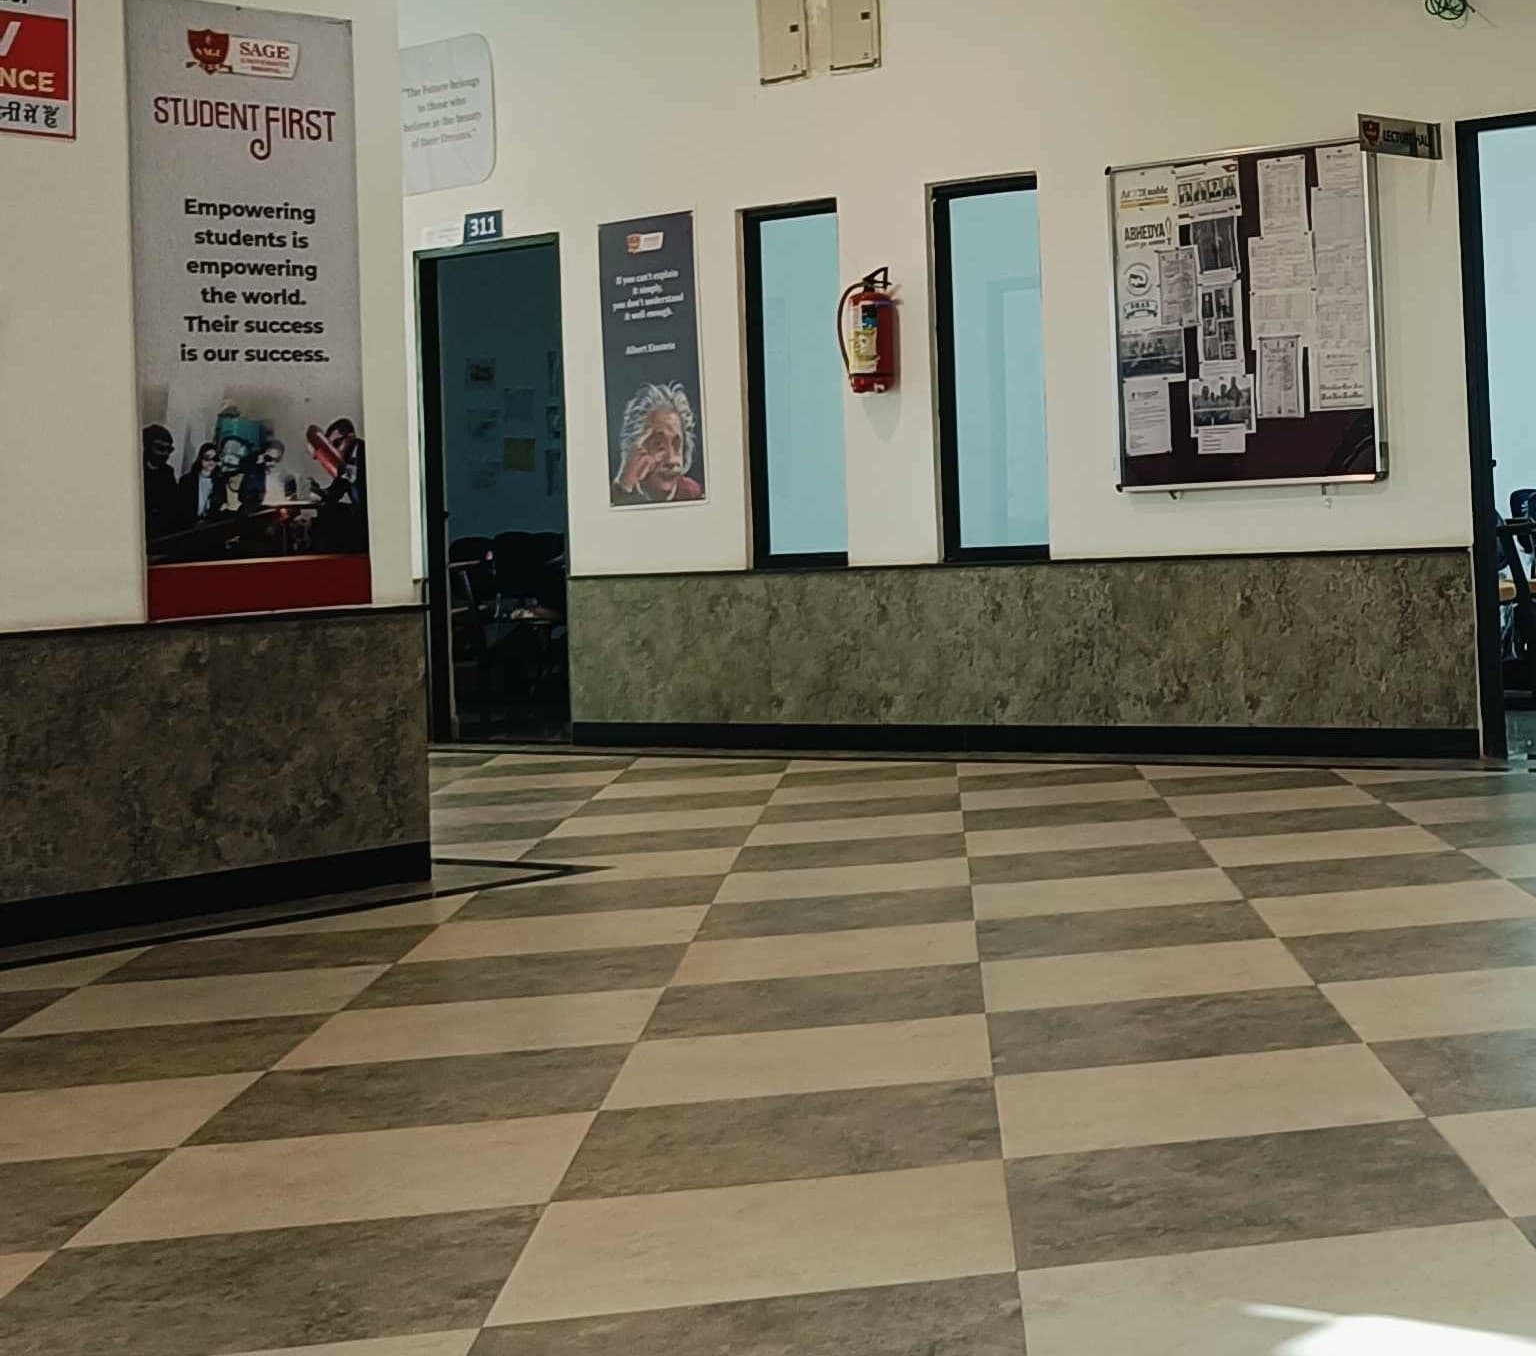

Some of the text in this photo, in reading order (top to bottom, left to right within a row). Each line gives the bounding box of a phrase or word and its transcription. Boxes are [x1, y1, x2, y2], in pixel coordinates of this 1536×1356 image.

[240, 42, 290, 60] SAGE
[153, 96, 336, 160] STUDENT FIRST
[184, 198, 316, 225] Empowering
[469, 215, 497, 237] 311
[1124, 223, 1165, 241] ABHEDYA
[194, 229, 309, 249] students is
[186, 259, 318, 281] empowering
[201, 286, 306, 306] the world.
[184, 315, 324, 334] Their success
[180, 344, 330, 362] is our success.
